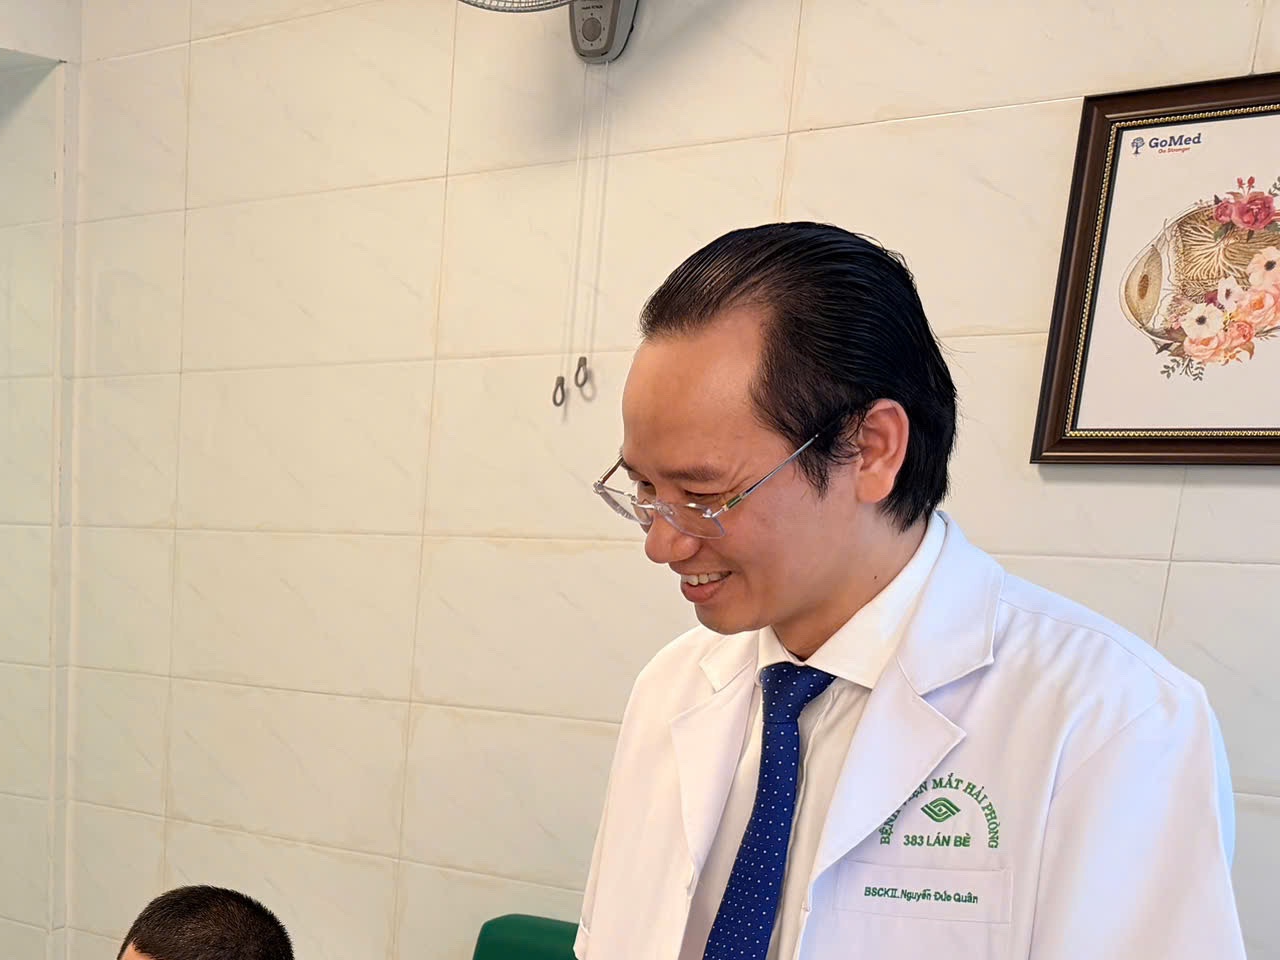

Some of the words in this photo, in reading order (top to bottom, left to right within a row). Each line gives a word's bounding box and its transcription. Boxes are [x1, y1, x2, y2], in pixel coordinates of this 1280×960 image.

[1149, 133, 1201, 148] GoMed
[932, 772, 964, 790] MẮT
[962, 782, 988, 804] HẢI
[981, 801, 1001, 849] PHÒNG
[903, 835, 924, 847] 383
[926, 831, 951, 847] LÁN
[953, 832, 971, 848] BÈ
[953, 891, 979, 903] Quân
